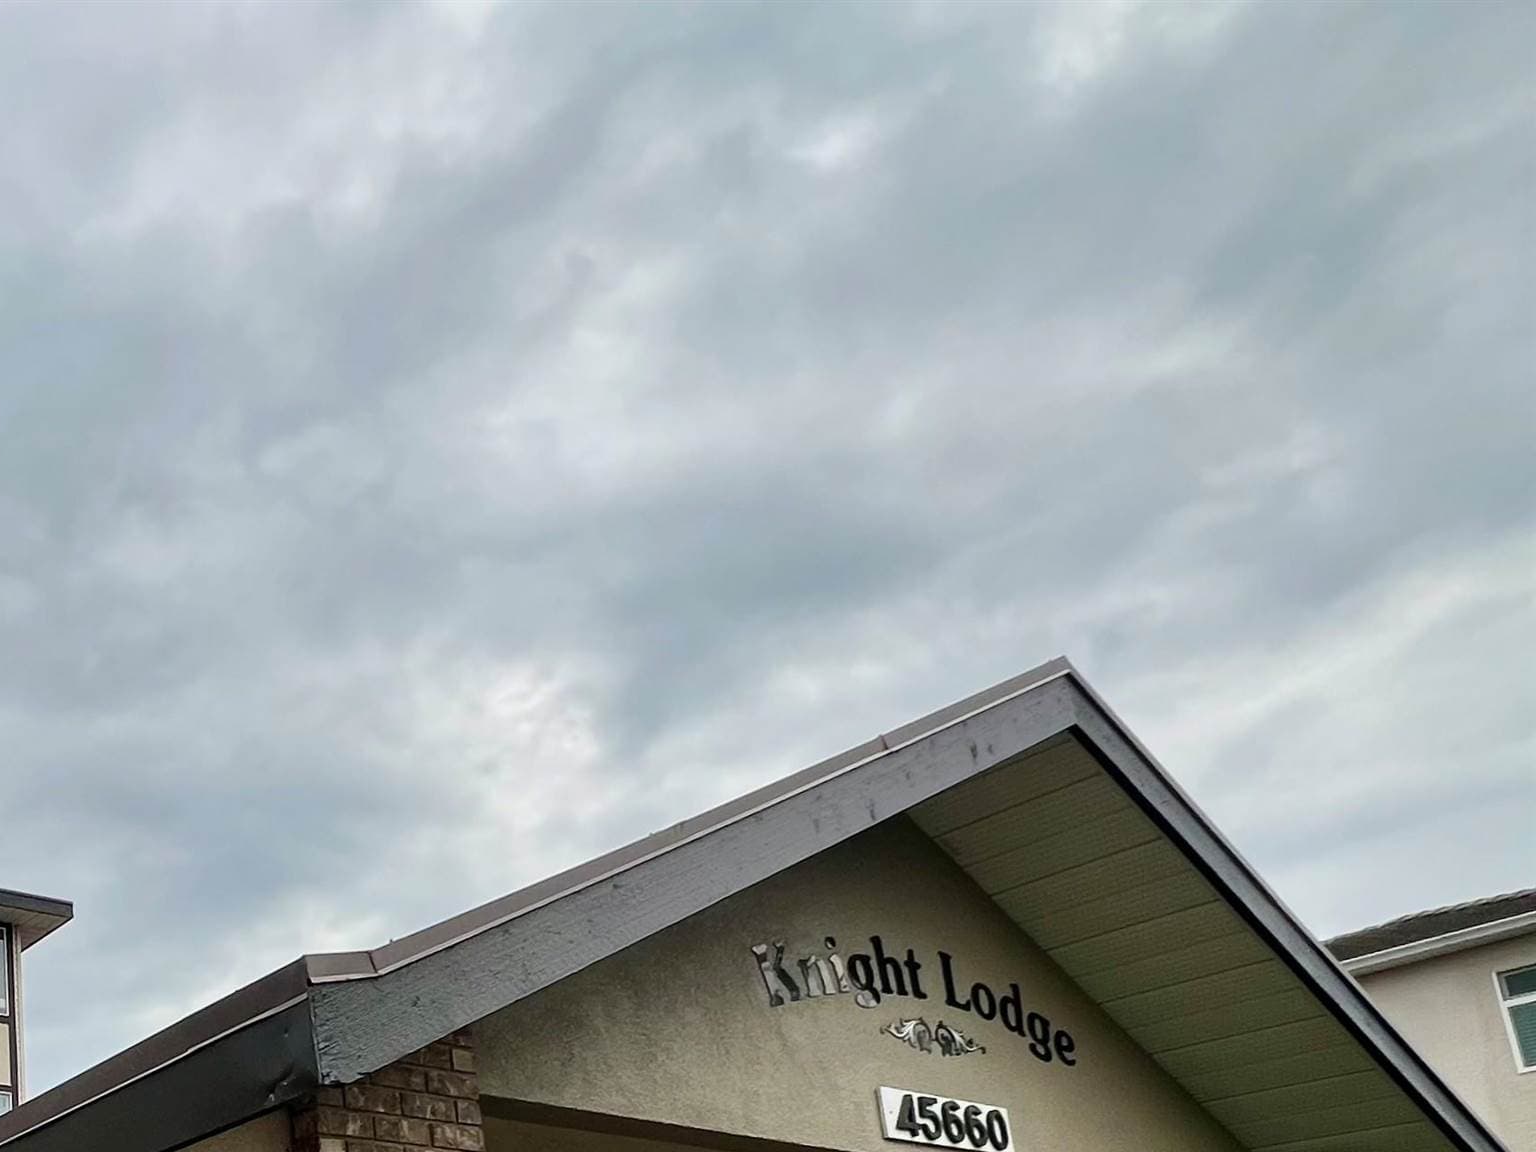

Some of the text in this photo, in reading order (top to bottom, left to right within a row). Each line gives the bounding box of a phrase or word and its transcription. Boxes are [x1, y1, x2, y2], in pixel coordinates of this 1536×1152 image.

[751, 935, 1076, 1066] Knight Lodge
[896, 1093, 1009, 1151] 45660
